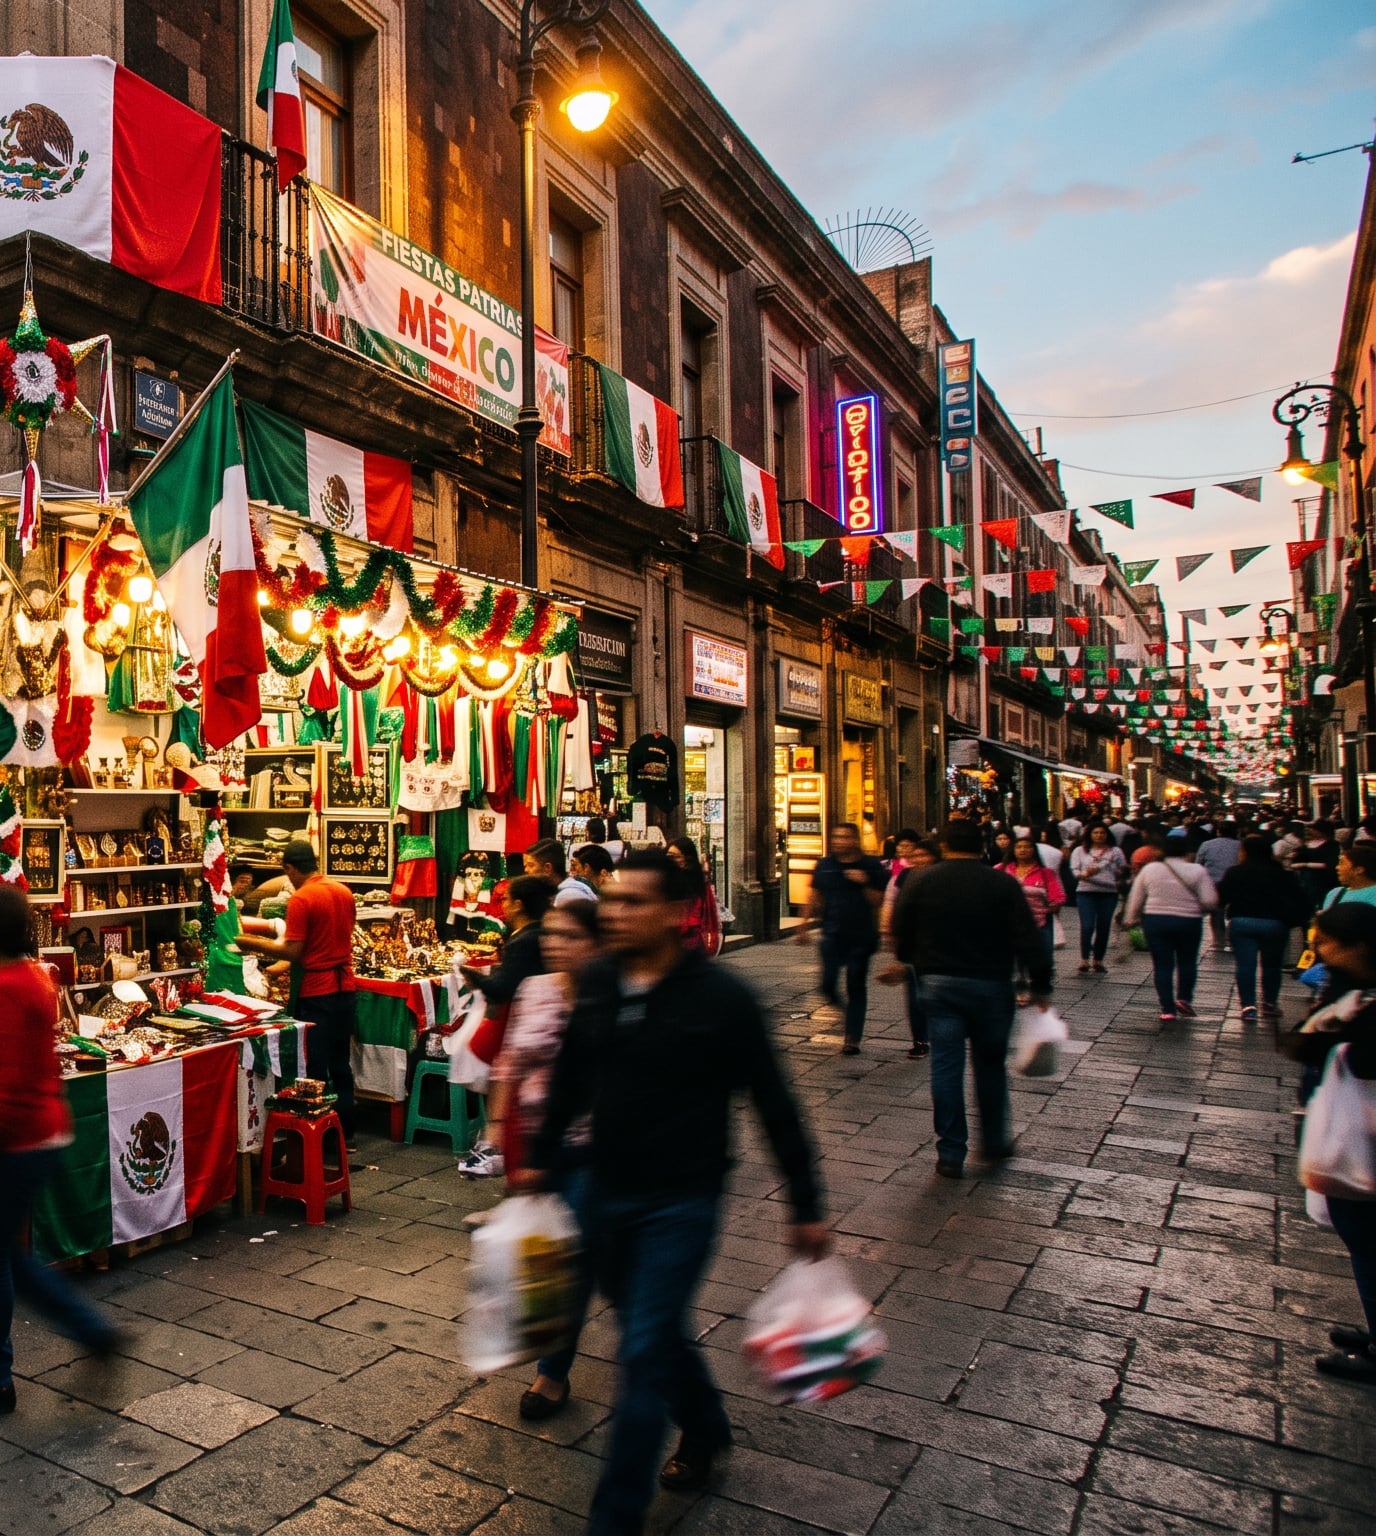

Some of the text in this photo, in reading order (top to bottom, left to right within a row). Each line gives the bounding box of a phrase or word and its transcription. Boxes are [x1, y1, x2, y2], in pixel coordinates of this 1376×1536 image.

[381, 229, 523, 334] FIESTAS PATRIAS
[398, 286, 515, 393] MÉXICO
